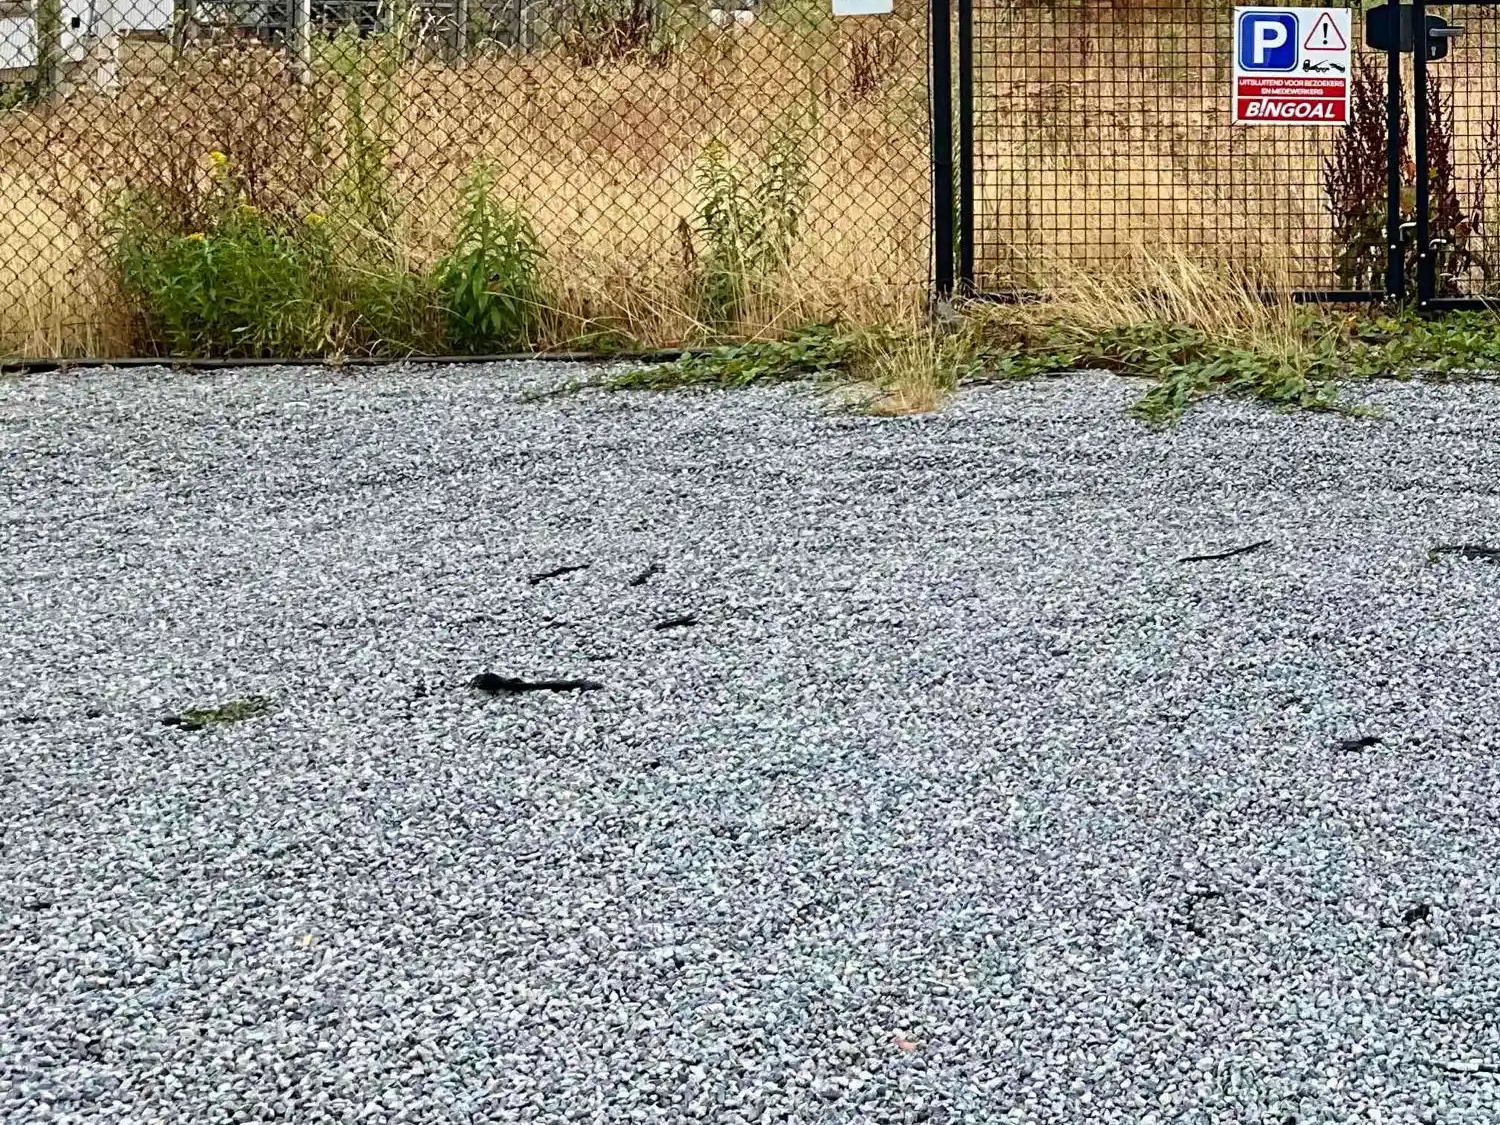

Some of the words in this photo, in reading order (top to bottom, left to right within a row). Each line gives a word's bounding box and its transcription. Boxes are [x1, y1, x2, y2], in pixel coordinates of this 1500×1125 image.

[1253, 20, 1288, 64] P
[1239, 79, 1283, 87] UITSLUITEND
[1283, 79, 1304, 87] VOOR
